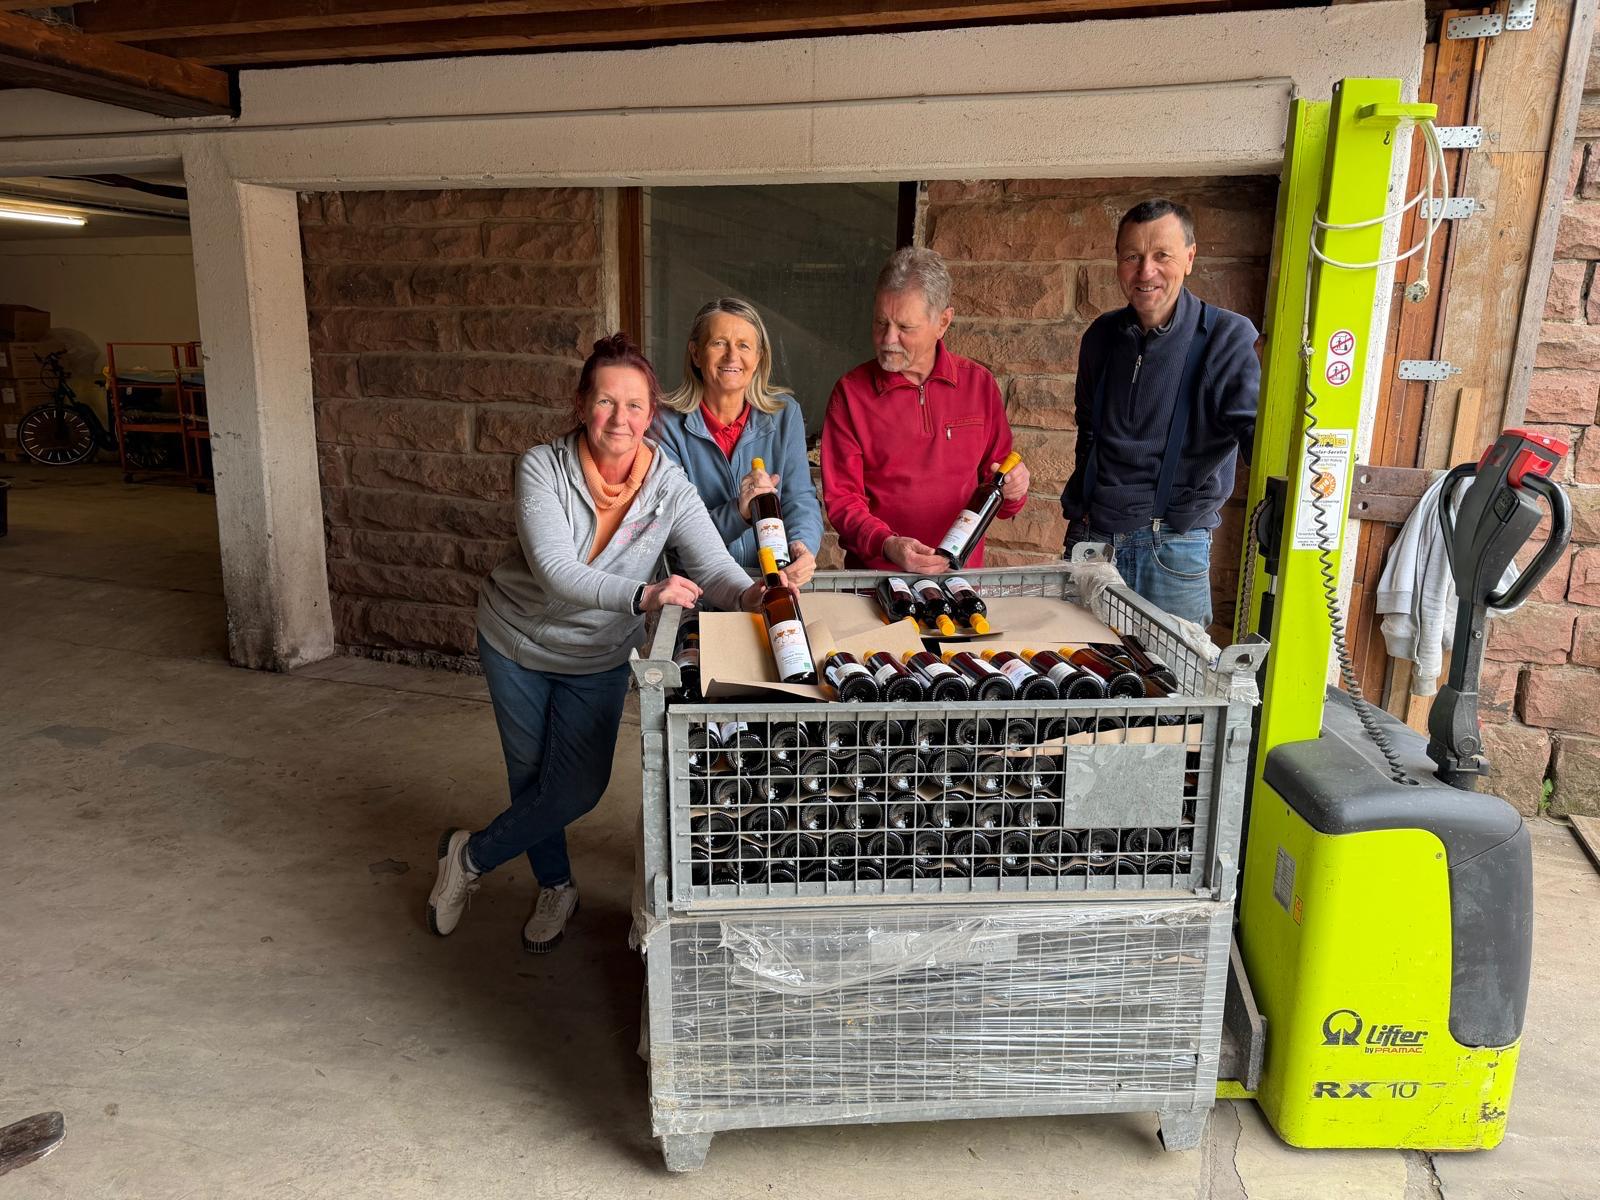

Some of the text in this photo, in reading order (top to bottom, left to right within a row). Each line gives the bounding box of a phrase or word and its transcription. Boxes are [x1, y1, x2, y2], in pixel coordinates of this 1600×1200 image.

[1365, 1024, 1428, 1047] Lifter
[1364, 1046, 1374, 1054] by
[1313, 1081, 1418, 1098] RX 10
